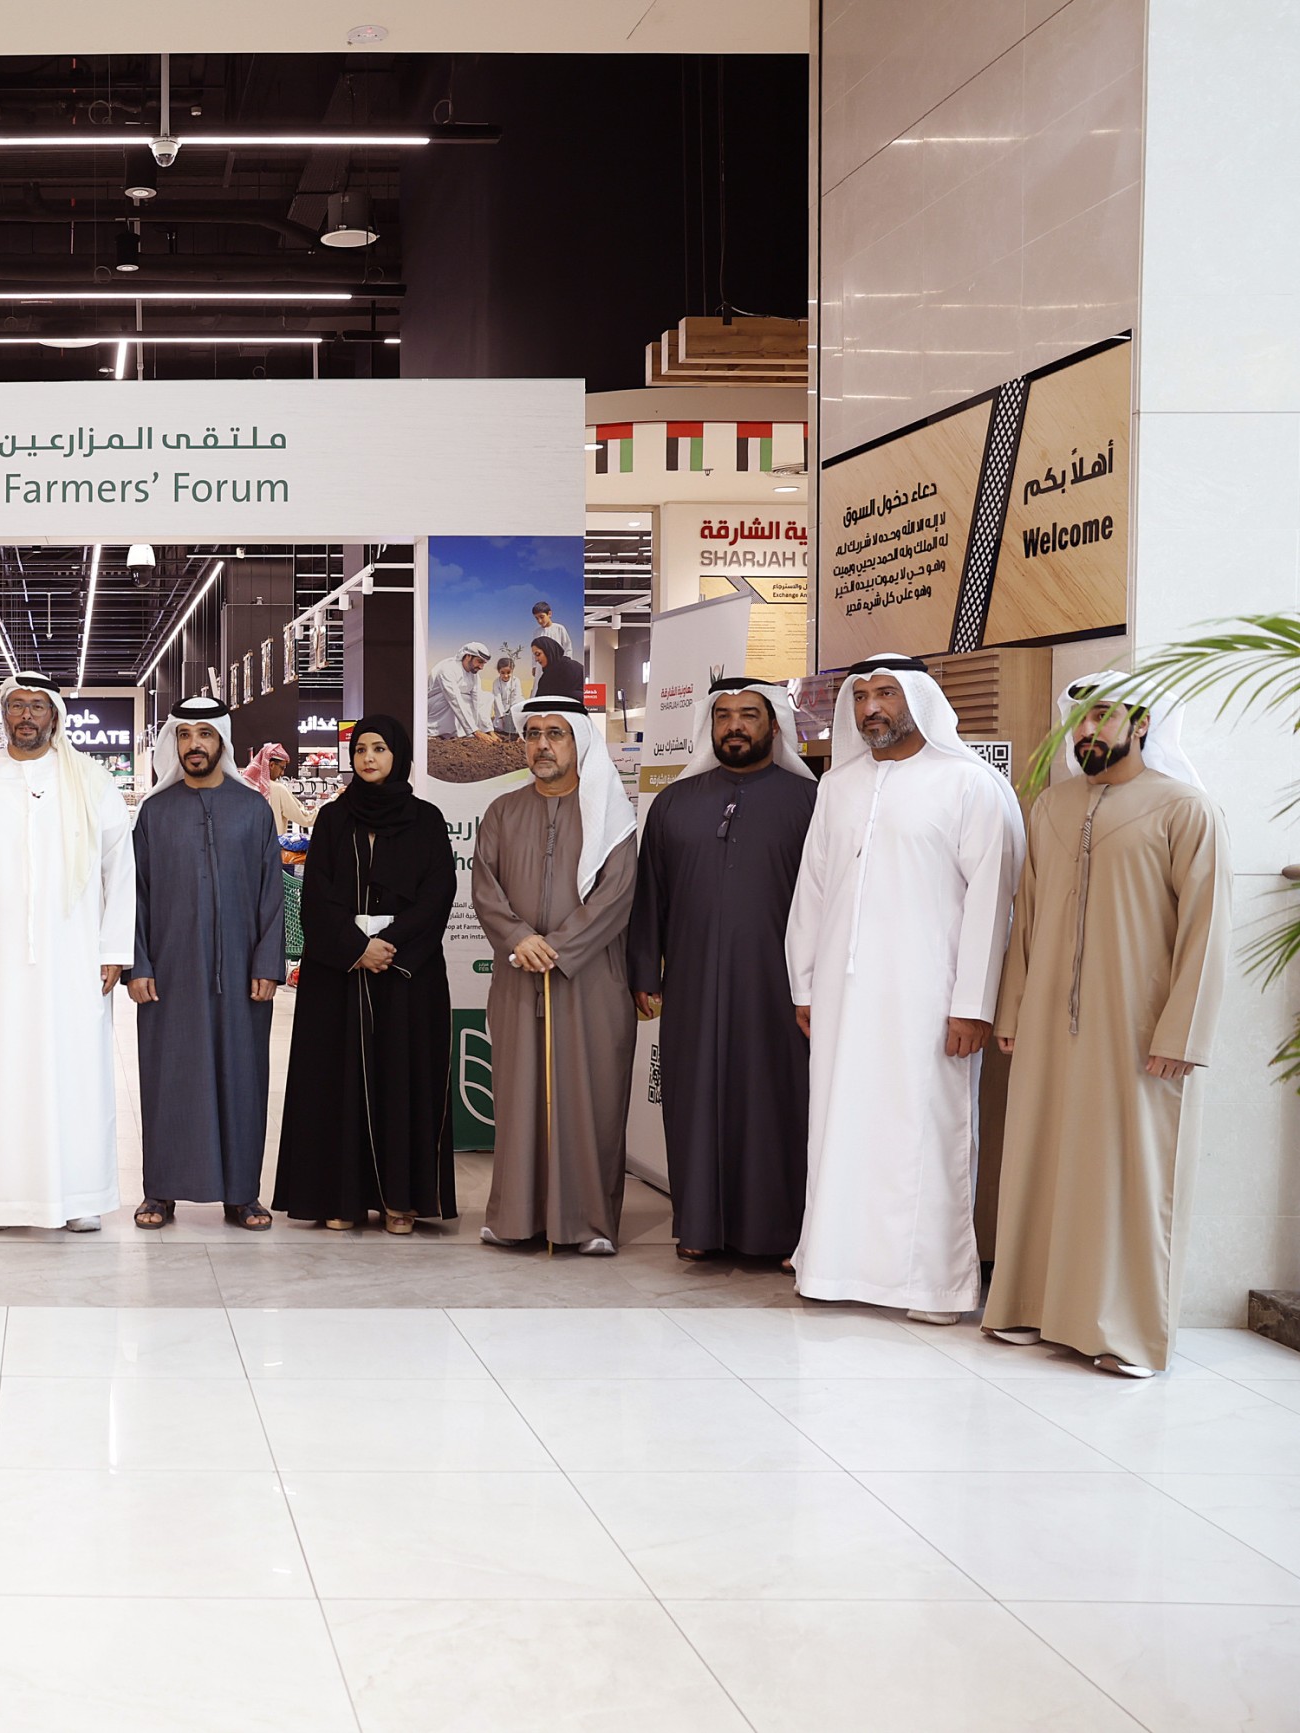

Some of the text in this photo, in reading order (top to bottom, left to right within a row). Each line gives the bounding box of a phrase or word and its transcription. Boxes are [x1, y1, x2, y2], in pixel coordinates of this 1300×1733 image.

[161, 426, 287, 450] ملتقى
[174, 472, 289, 503] Forum
[1023, 466, 1067, 506] بكم
[842, 482, 938, 529] دعاء دخول السوق
[700, 517, 781, 547] الشارقة
[847, 532, 872, 555] شريك
[878, 529, 902, 542] وحده
[1022, 515, 1114, 559] Welcome
[913, 536, 938, 555] الملك
[700, 549, 796, 568] SHARJAH
[926, 559, 947, 576] وهو
[834, 580, 855, 599] الخير
